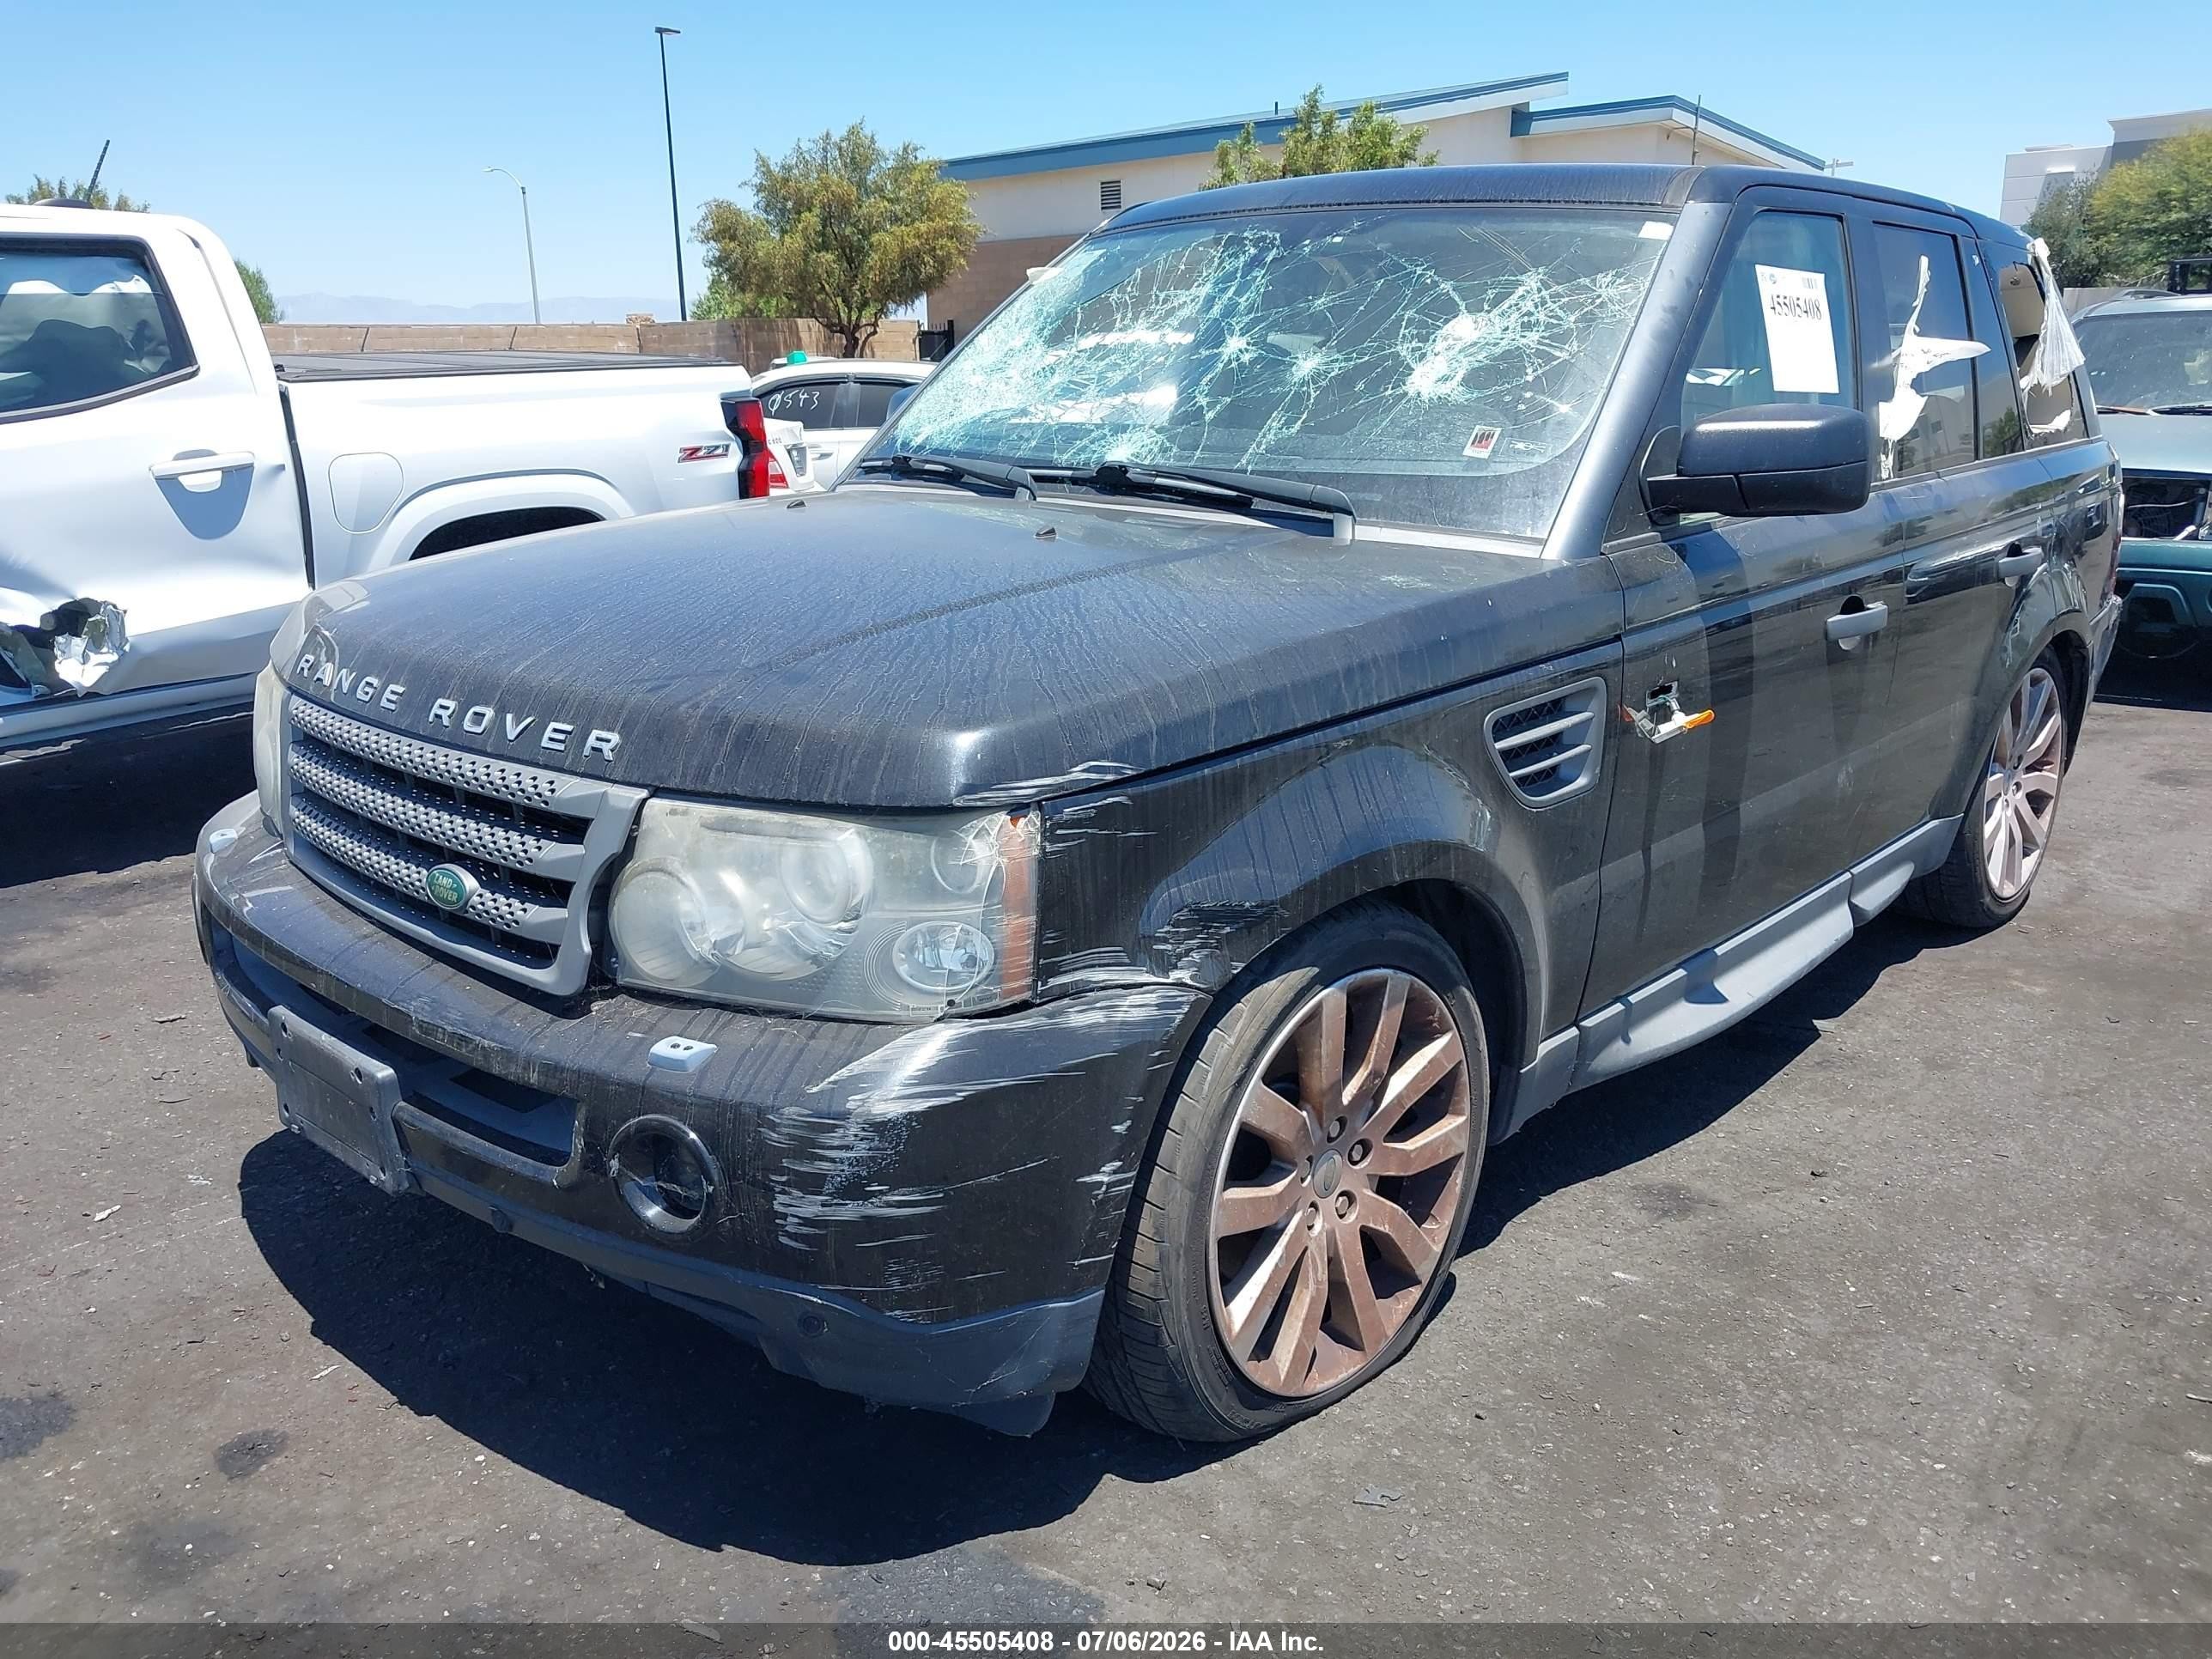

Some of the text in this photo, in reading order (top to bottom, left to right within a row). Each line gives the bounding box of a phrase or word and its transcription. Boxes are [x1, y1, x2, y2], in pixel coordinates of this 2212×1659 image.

[1770, 295, 1822, 320] 45505408
[678, 443, 732, 464] Z71
[296, 653, 623, 763] RANGE ROVER
[434, 872, 453, 888] LAND
[434, 885, 459, 902] ROVER
